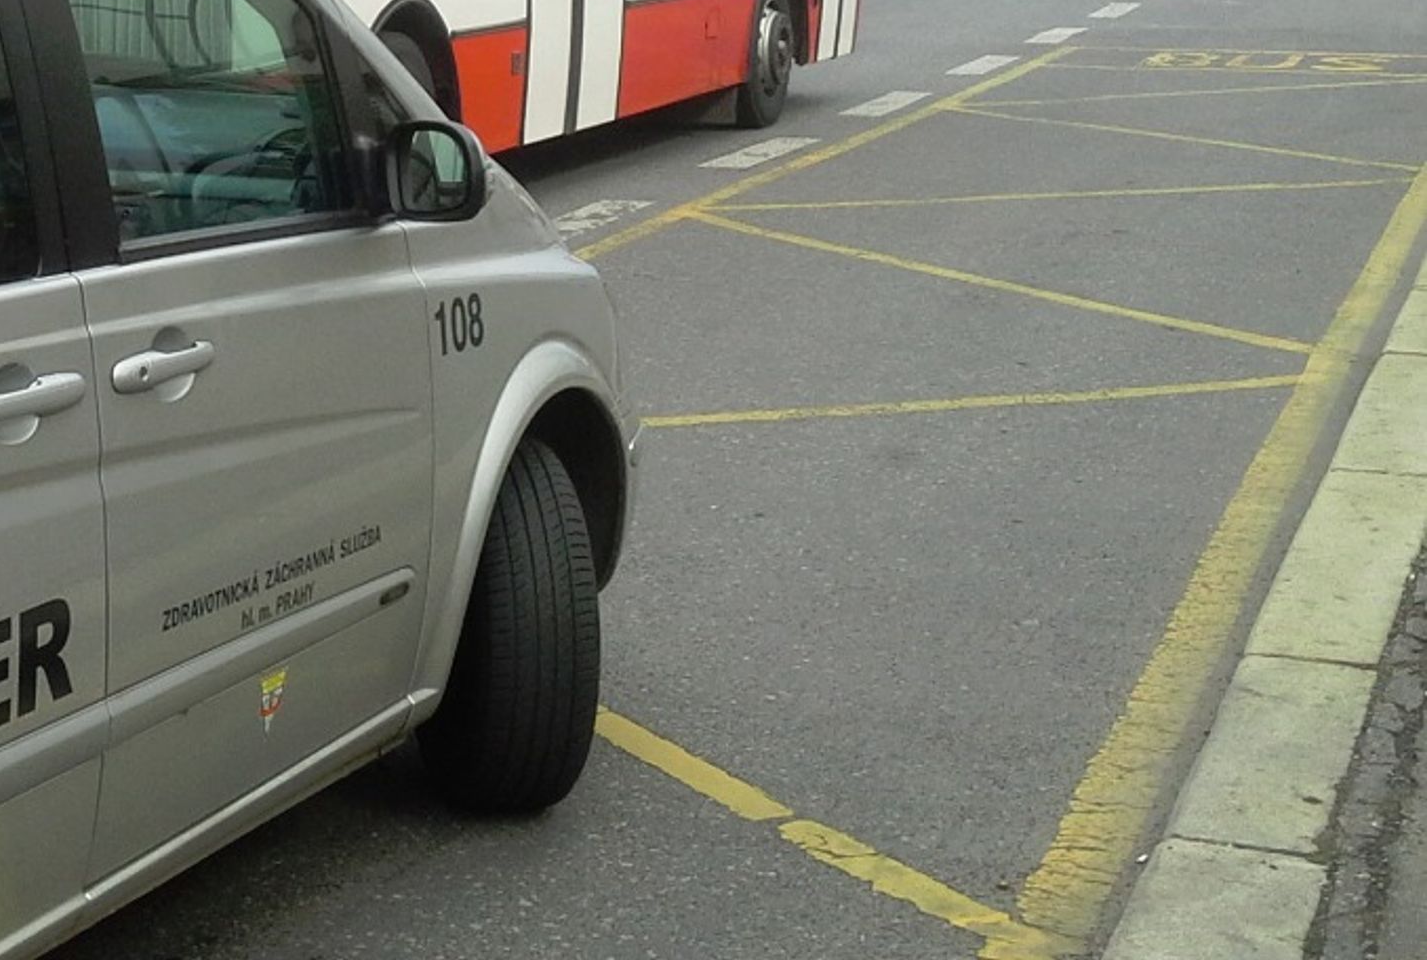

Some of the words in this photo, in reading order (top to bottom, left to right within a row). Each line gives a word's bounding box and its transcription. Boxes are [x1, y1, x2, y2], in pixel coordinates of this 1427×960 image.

[434, 292, 484, 356] 108
[161, 569, 260, 632] ZDRAVOTNICKÁ
[265, 539, 335, 589] ZÁCHRANNÁ
[340, 525, 381, 559] SLUŽBA
[275, 581, 315, 616] PRAHY
